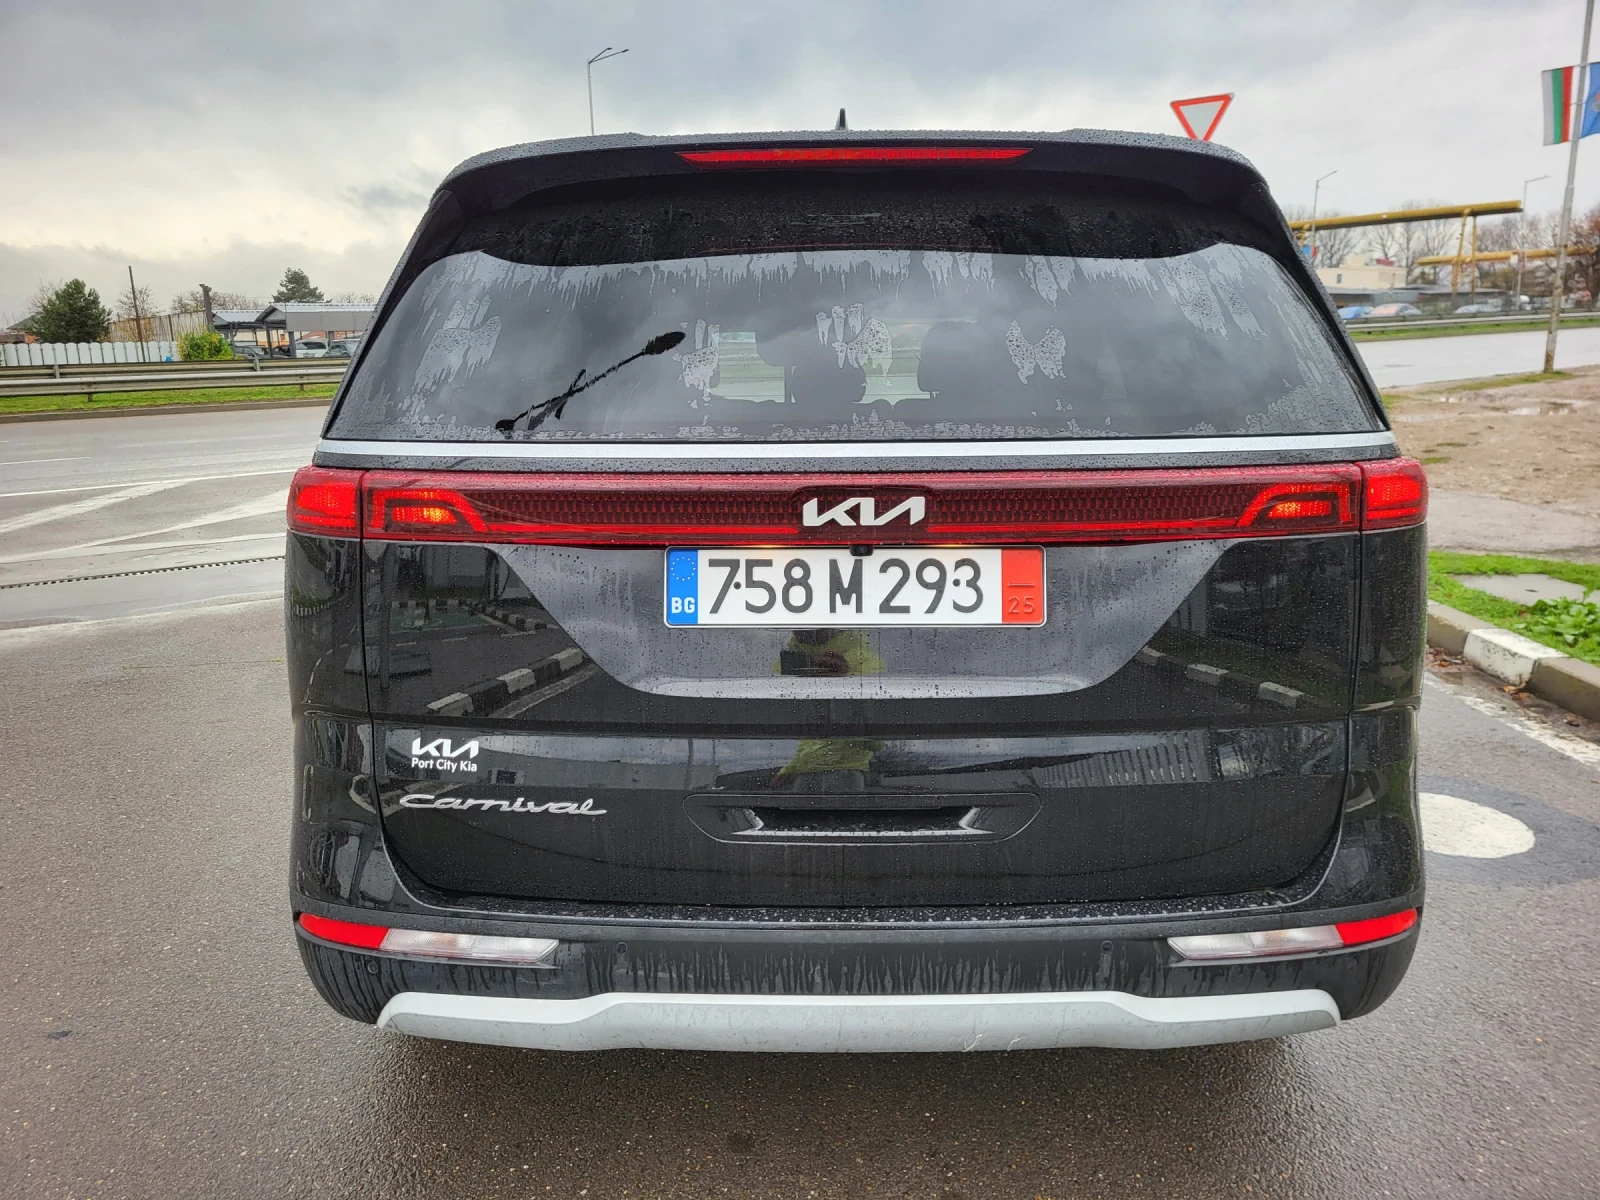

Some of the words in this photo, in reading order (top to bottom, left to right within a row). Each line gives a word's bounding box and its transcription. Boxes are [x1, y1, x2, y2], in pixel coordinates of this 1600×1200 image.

[803, 496, 925, 526] KIA
[708, 558, 813, 614] 758
[829, 559, 863, 614] M
[879, 558, 984, 614] 293
[671, 597, 695, 614] BG
[1008, 596, 1034, 614] 25
[412, 737, 479, 758] KIA
[411, 757, 434, 769] Port
[436, 759, 458, 773] City
[460, 761, 477, 772] Kia
[400, 794, 607, 815] Carnival
